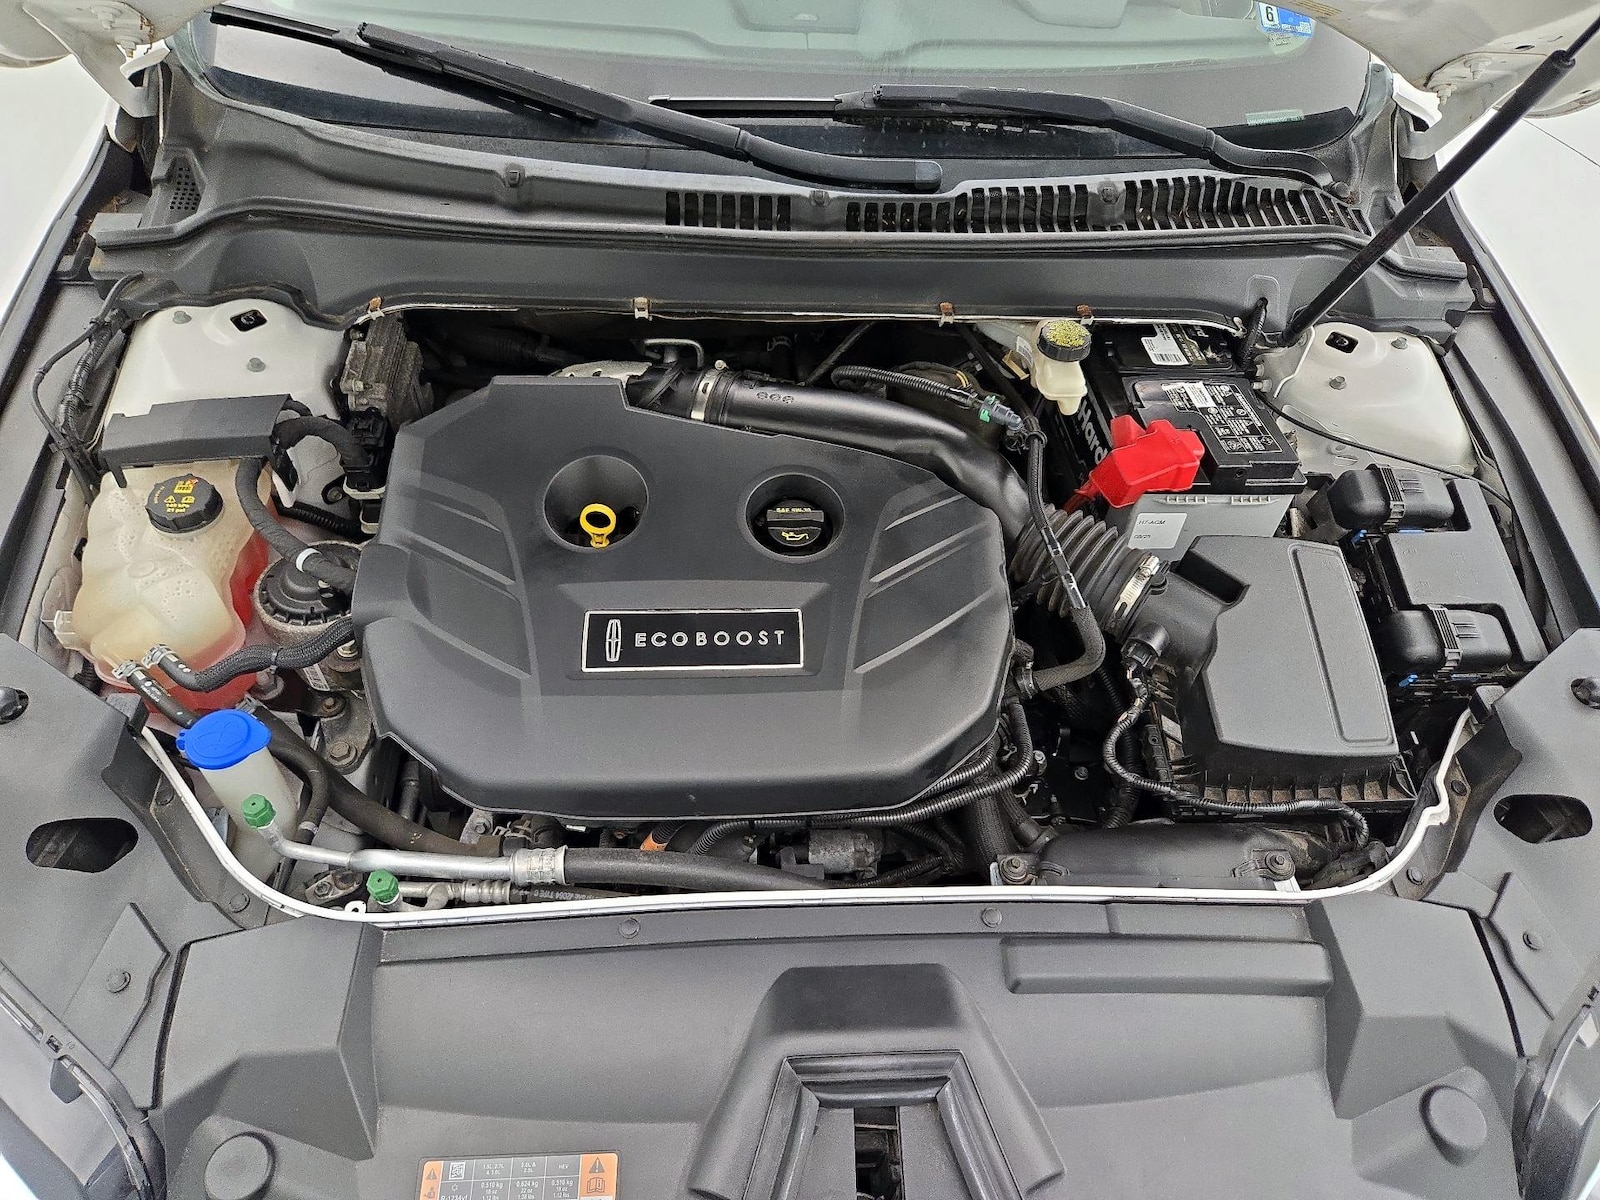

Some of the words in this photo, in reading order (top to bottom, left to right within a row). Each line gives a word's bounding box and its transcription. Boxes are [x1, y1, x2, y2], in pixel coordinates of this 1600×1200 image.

[1265, 6, 1275, 22] 6
[635, 630, 785, 647] ECOBOOST
[496, 1181, 504, 1189] kg
[531, 1180, 539, 1188] kg
[566, 1179, 574, 1187] kg
